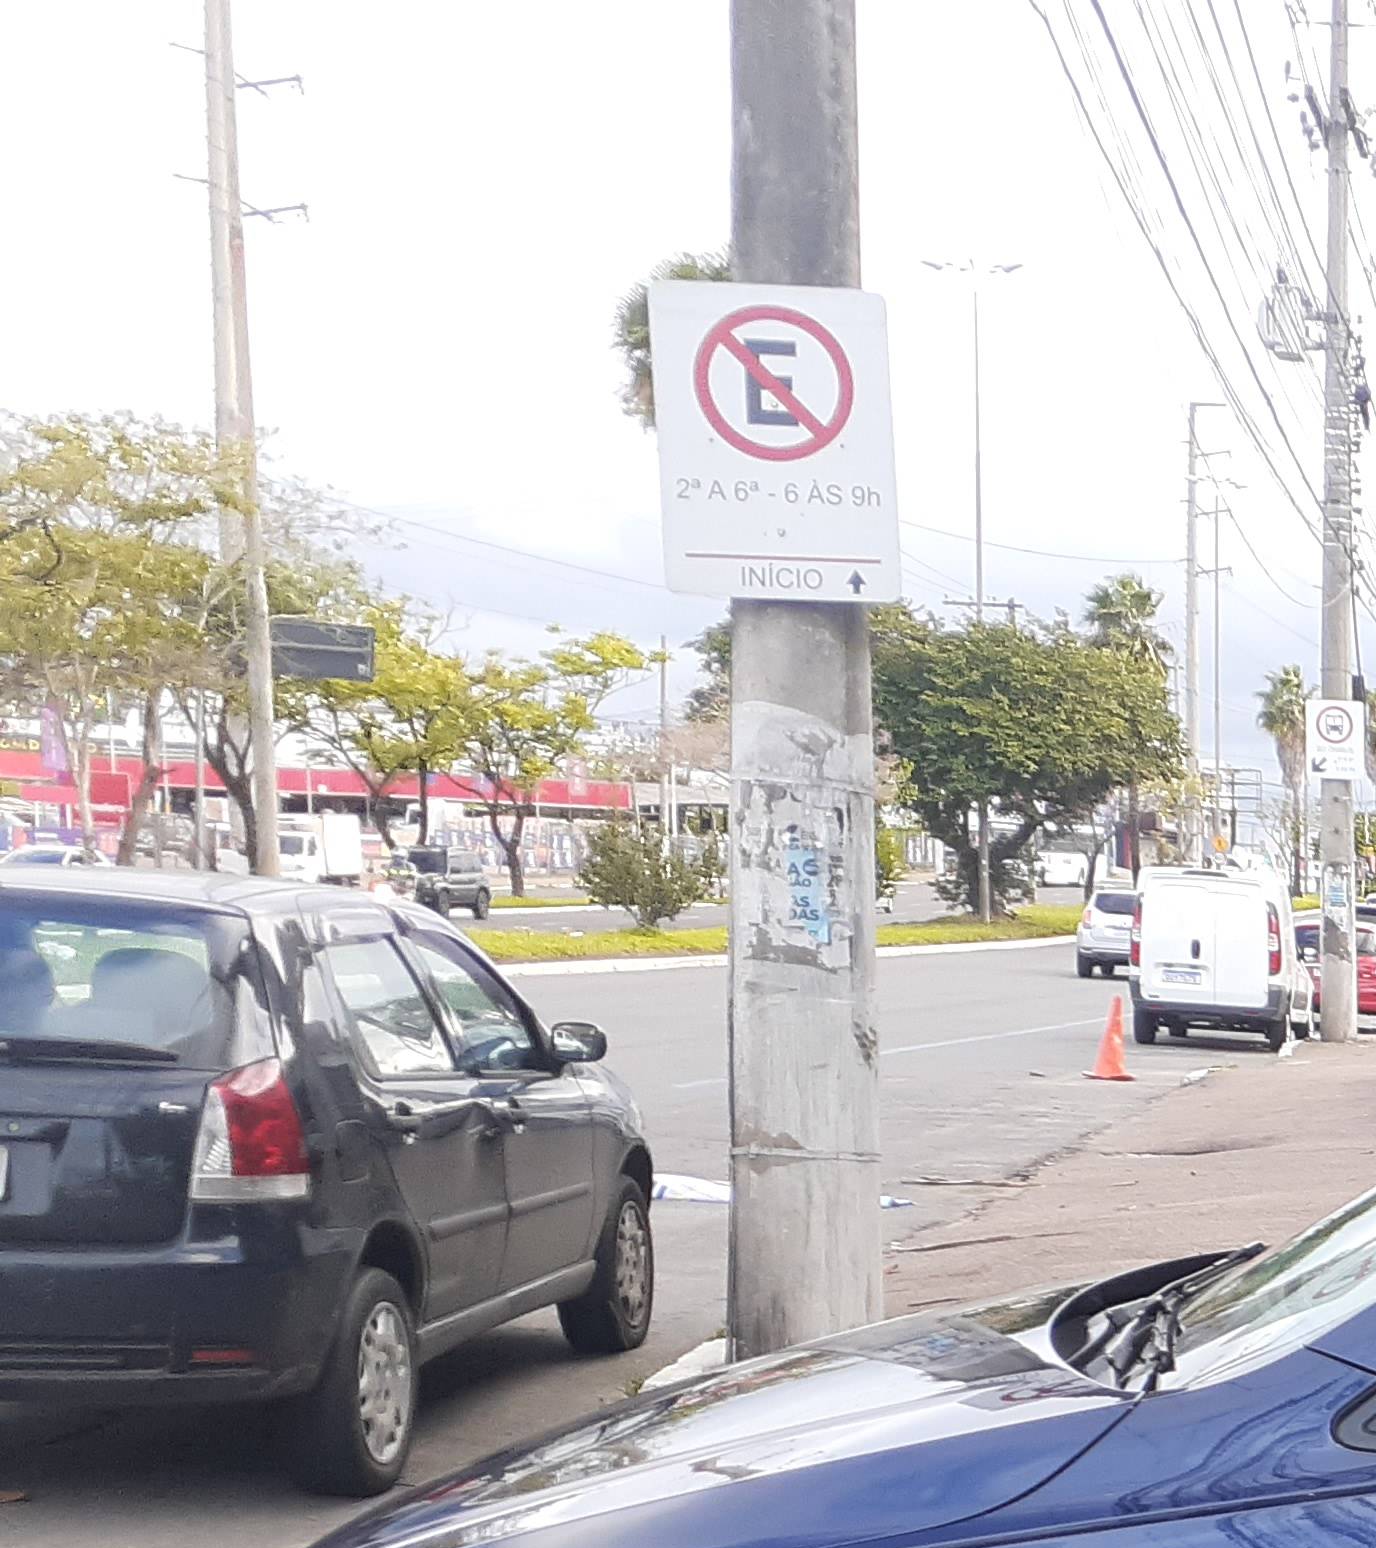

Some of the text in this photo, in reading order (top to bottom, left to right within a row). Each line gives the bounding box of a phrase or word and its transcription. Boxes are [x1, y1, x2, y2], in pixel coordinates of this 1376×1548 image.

[708, 480, 727, 502] A
[784, 483, 799, 504] 6
[852, 486, 881, 508] 9h
[741, 564, 824, 590] INÍCIO
